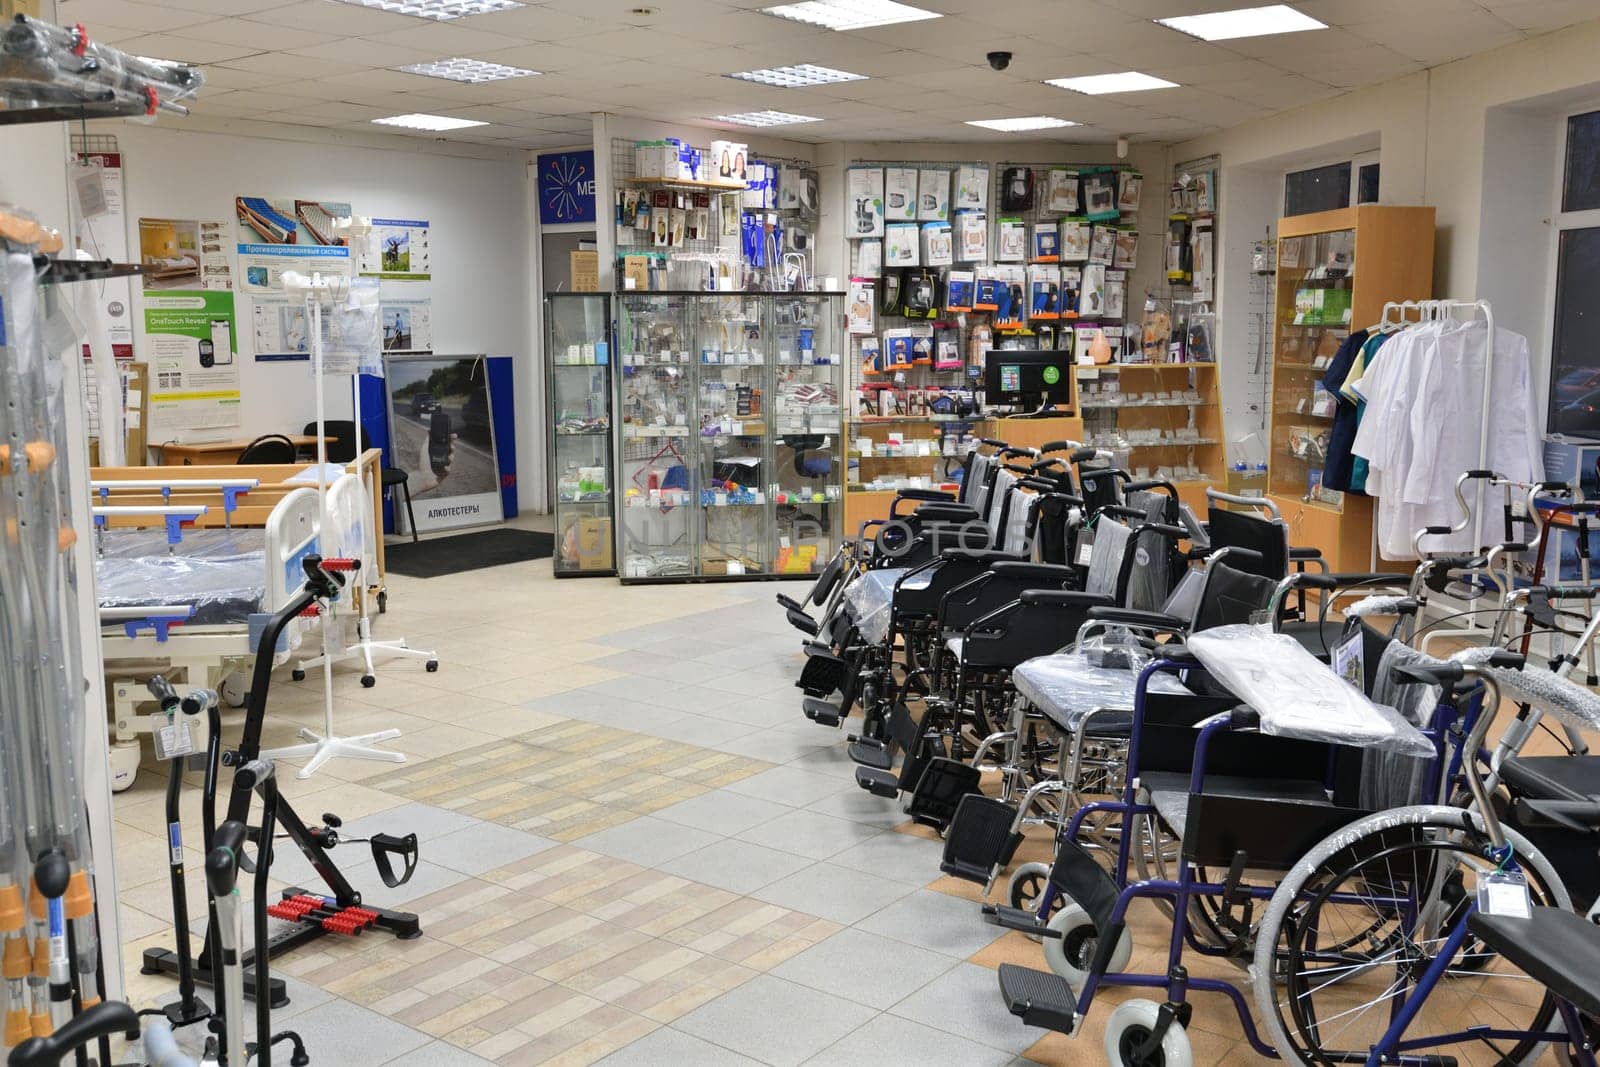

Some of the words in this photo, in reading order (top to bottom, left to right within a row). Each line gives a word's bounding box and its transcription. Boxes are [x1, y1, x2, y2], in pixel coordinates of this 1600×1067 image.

[246, 245, 320, 255] Противопролежневые
[320, 248, 347, 256] системы
[150, 317, 184, 325] OneTouch
[185, 317, 207, 325] Reveal
[428, 504, 480, 519] АЛКОТЕСТЕРЫ
